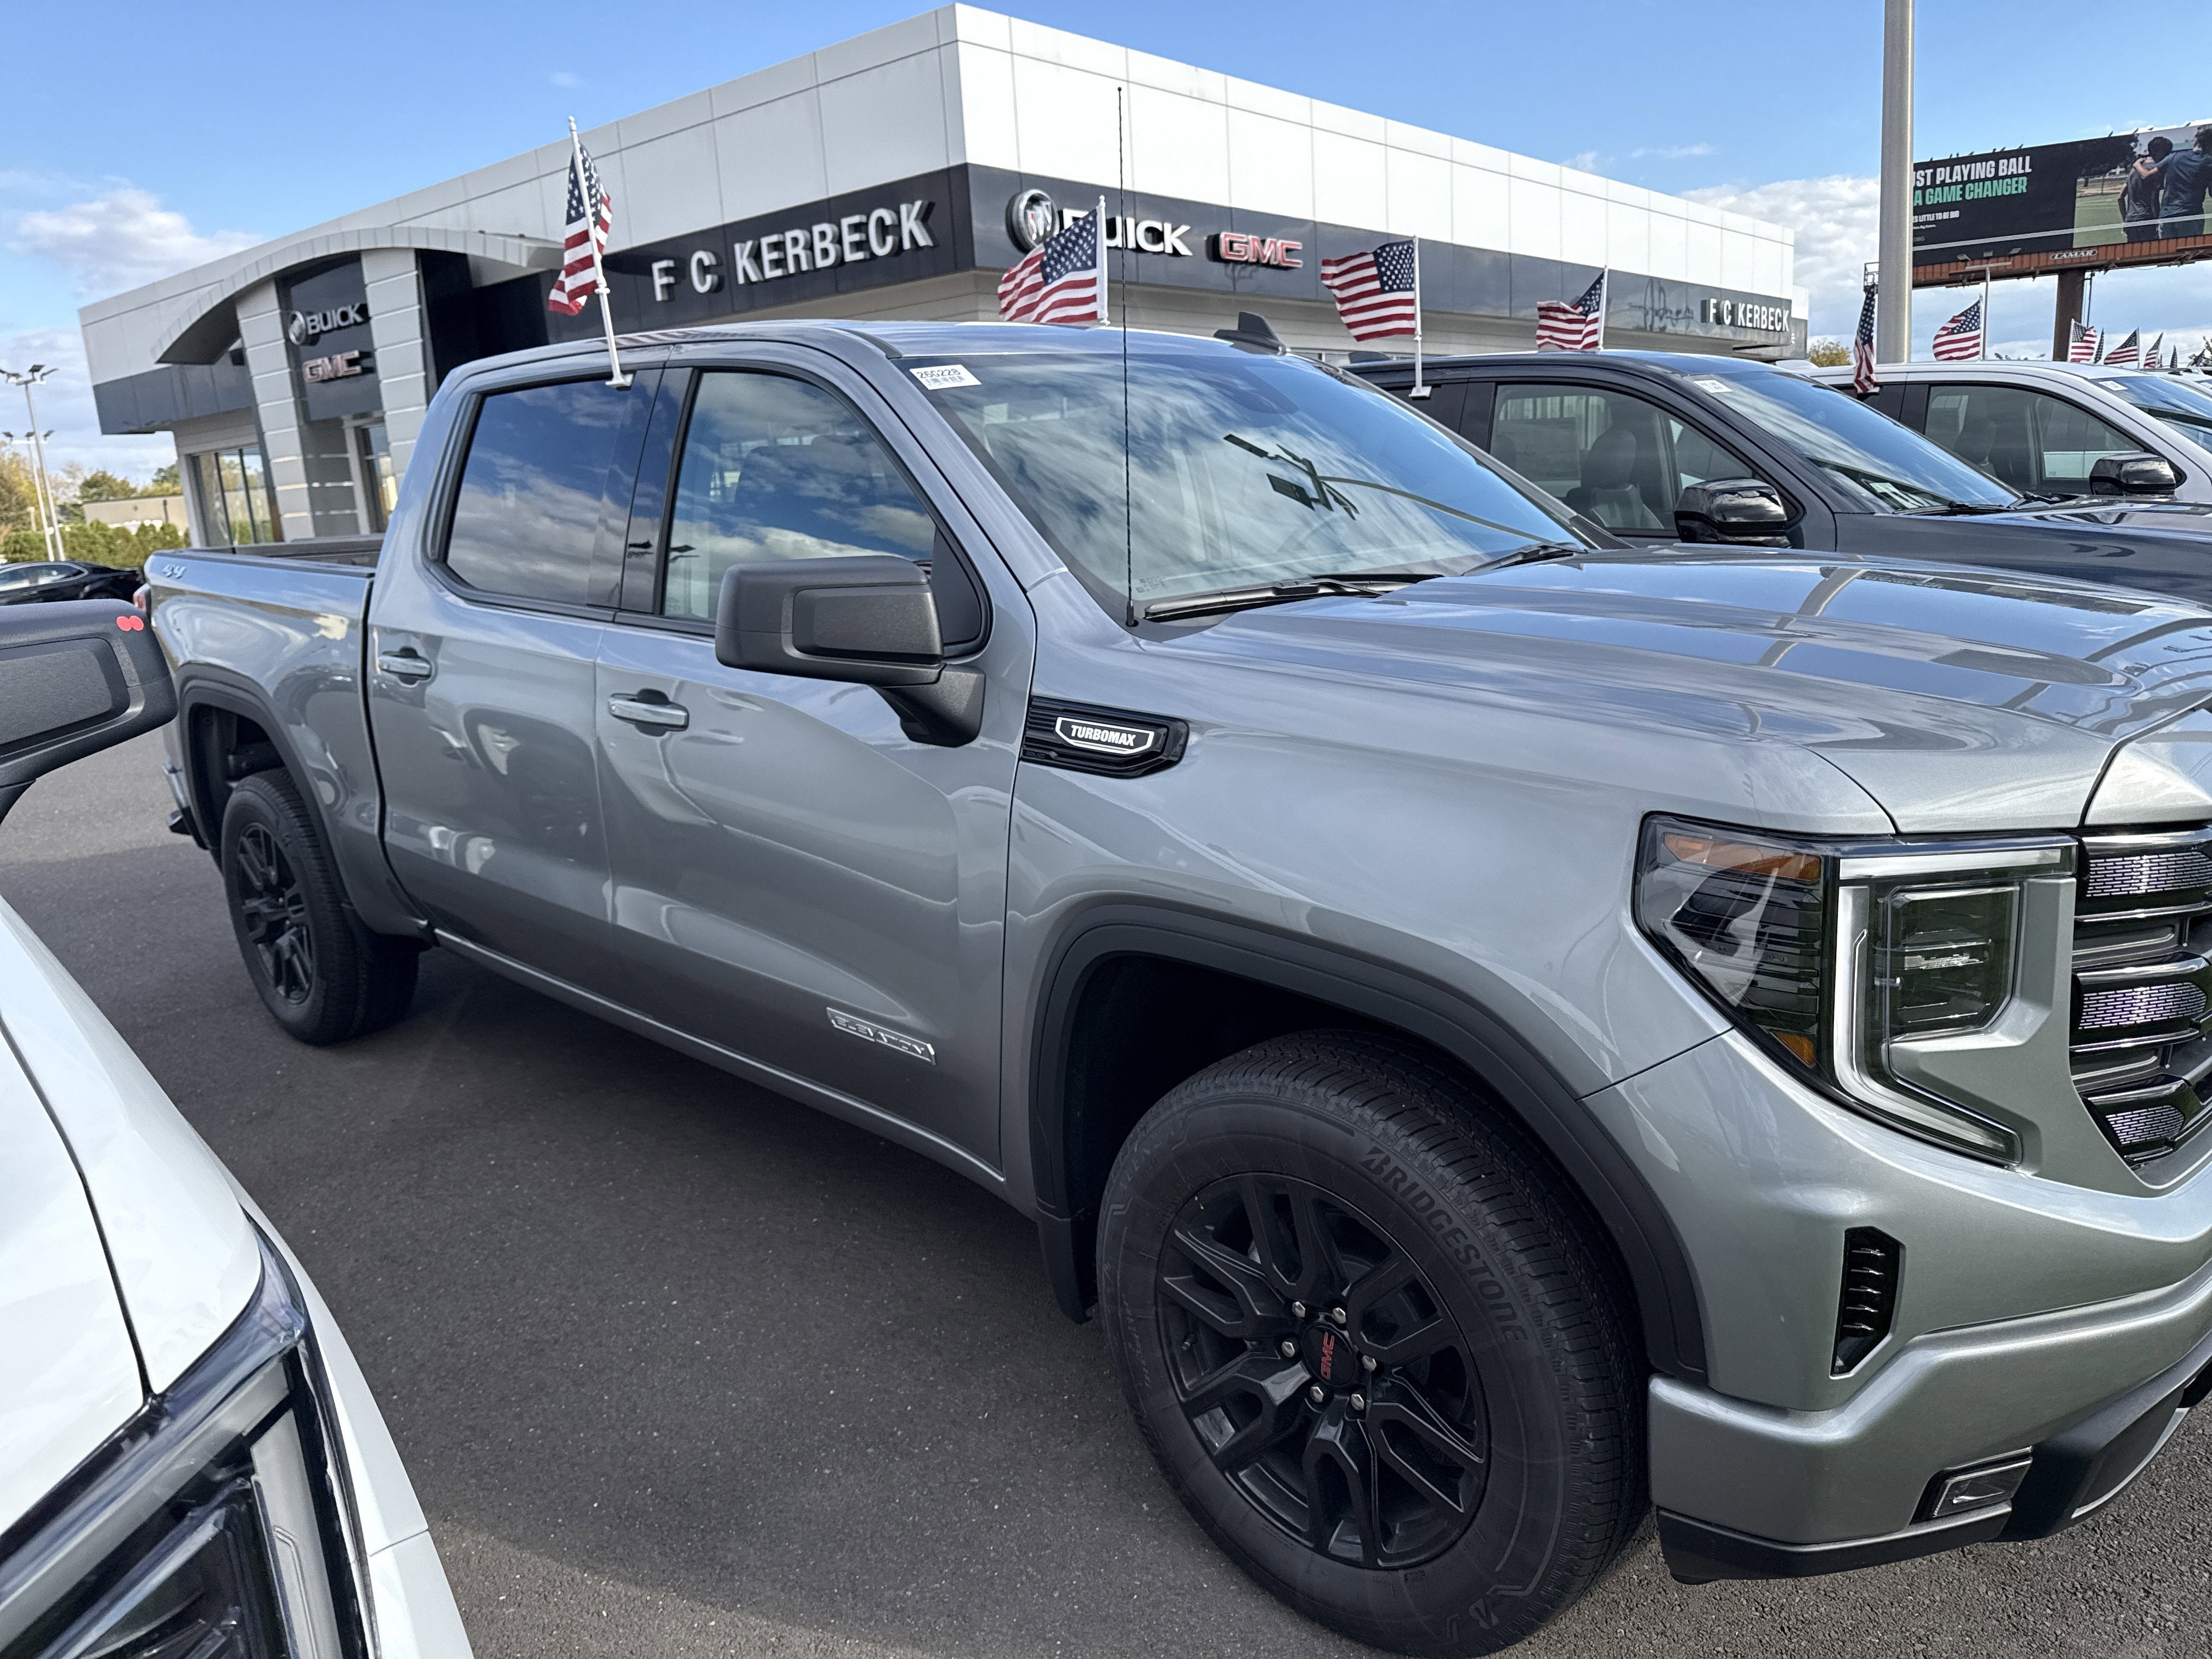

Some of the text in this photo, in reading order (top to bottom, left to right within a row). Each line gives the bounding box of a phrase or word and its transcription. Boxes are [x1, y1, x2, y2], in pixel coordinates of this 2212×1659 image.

[1936, 160, 1996, 185] PLAYING
[1998, 155, 2032, 177] BALL
[1914, 176, 2028, 206] A GAME CHANGER
[651, 199, 934, 302] F C KERBECK
[1220, 232, 1303, 268] GMC
[307, 302, 364, 335] BUICK
[1709, 298, 1790, 332] F C KERBECK
[303, 350, 363, 383] GMC
[1071, 725, 1136, 747] TURBOMAX
[1359, 1146, 1530, 1342] BRIDGESTONE
[1321, 1331, 1335, 1380] GMC
